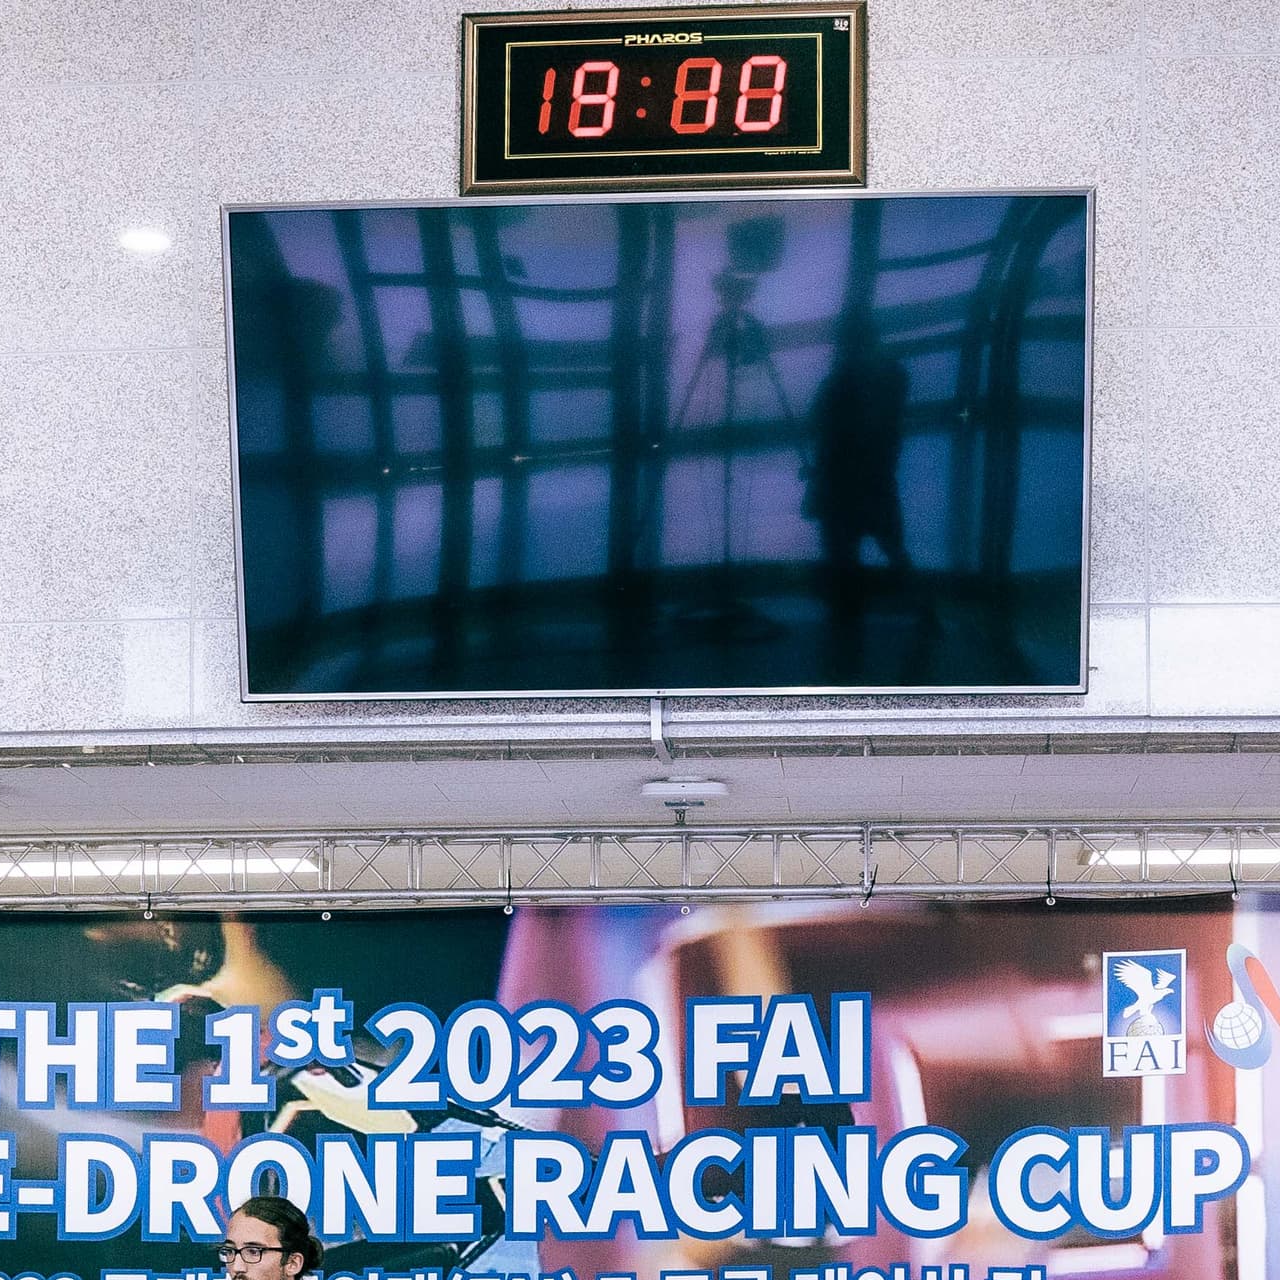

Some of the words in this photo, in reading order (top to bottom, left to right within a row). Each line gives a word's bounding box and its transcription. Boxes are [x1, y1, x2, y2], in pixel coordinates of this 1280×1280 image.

[624, 33, 703, 46] PHAROS
[208, 992, 350, 1104] 1st
[374, 1004, 656, 1104] 2023
[694, 1000, 864, 1098] FAI
[1109, 1040, 1180, 1072] FAI
[515, 1131, 962, 1236] RACING
[995, 1130, 1244, 1234] CUP
